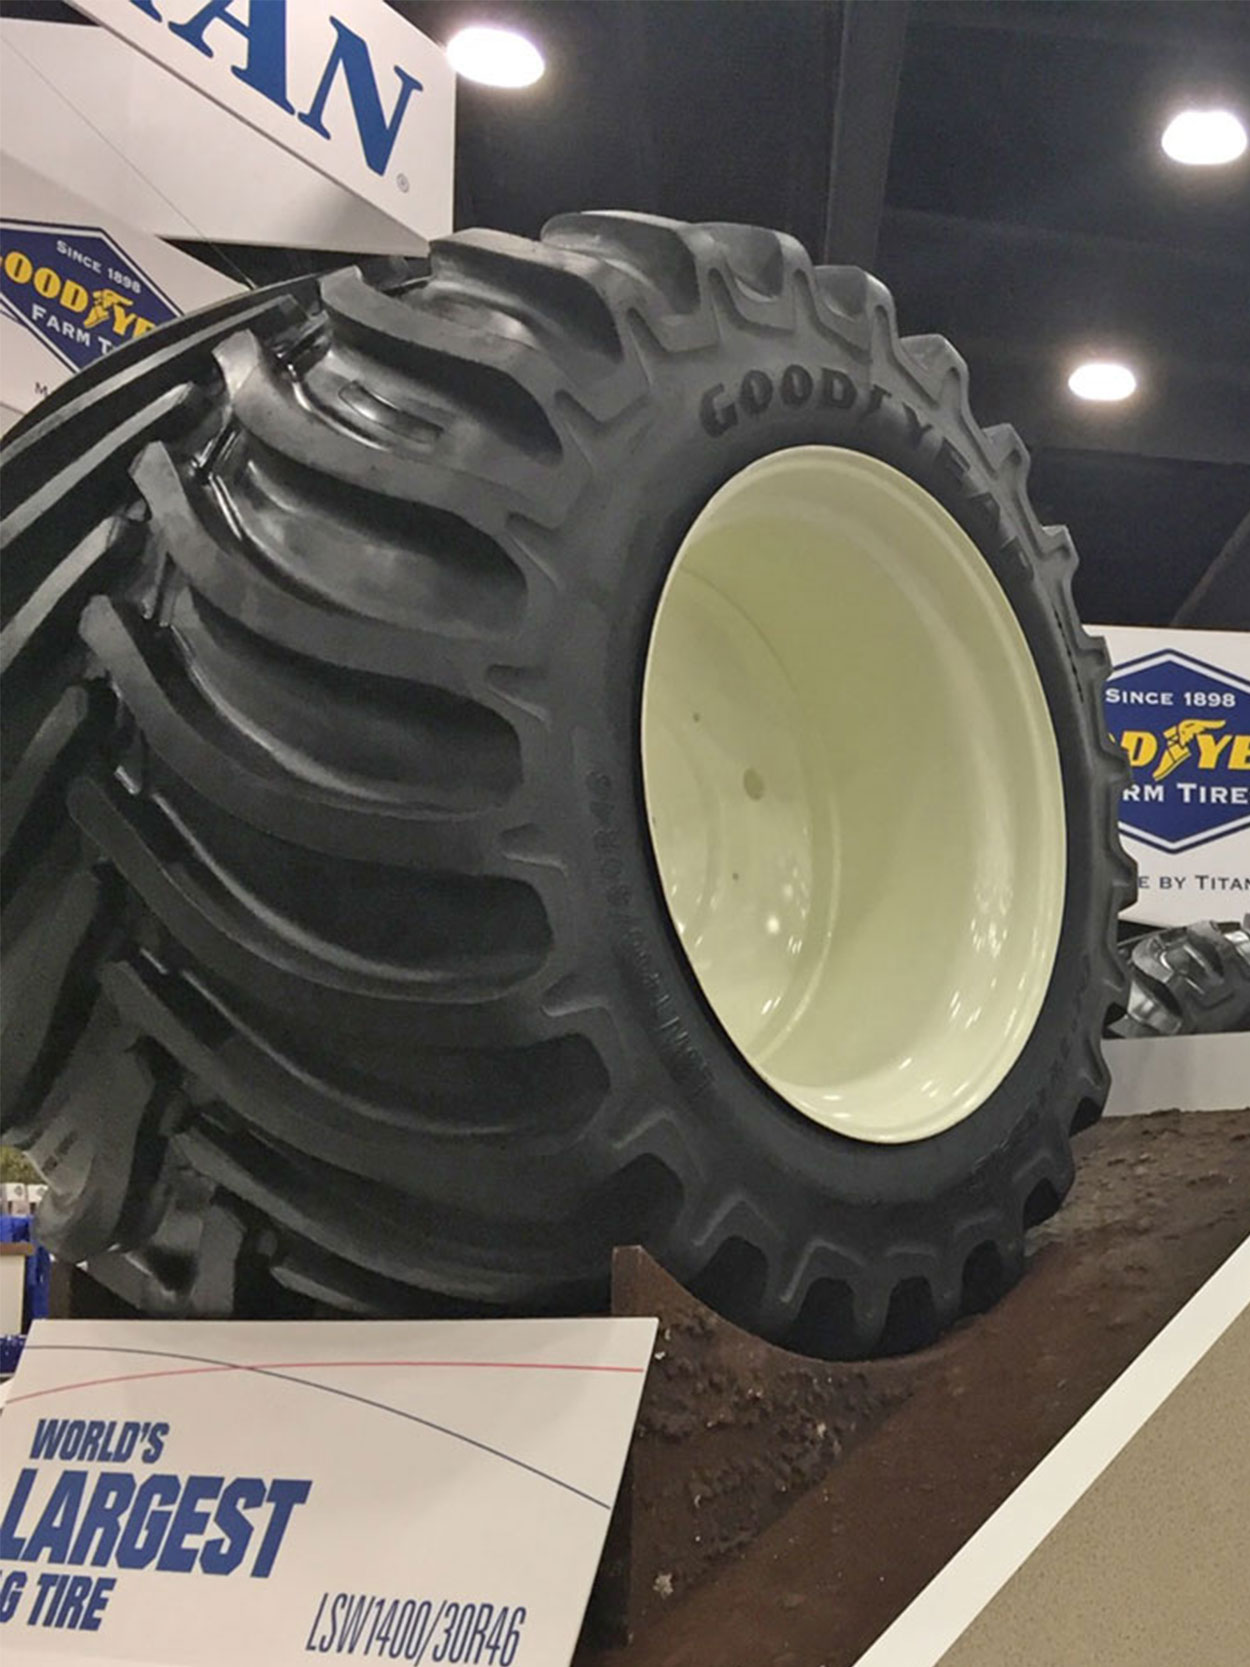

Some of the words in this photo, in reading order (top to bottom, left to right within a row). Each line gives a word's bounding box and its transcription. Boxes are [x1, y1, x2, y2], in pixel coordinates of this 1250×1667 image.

[128, 0, 423, 176] AN
[0, 251, 156, 338] OODY
[56, 240, 101, 274] SINCE
[107, 267, 142, 294] 1898
[31, 303, 91, 347] FARM
[98, 336, 116, 355] T
[1106, 688, 1174, 706] SINCE
[1184, 692, 1236, 708] 1898
[1159, 876, 1187, 890] BY
[29, 1418, 170, 1464] WORLD'S
[0, 1468, 313, 1578] LARGEST
[0, 1569, 28, 1624] G
[27, 1572, 117, 1632] TIRE
[305, 1592, 527, 1667] LSW1400/30R46
